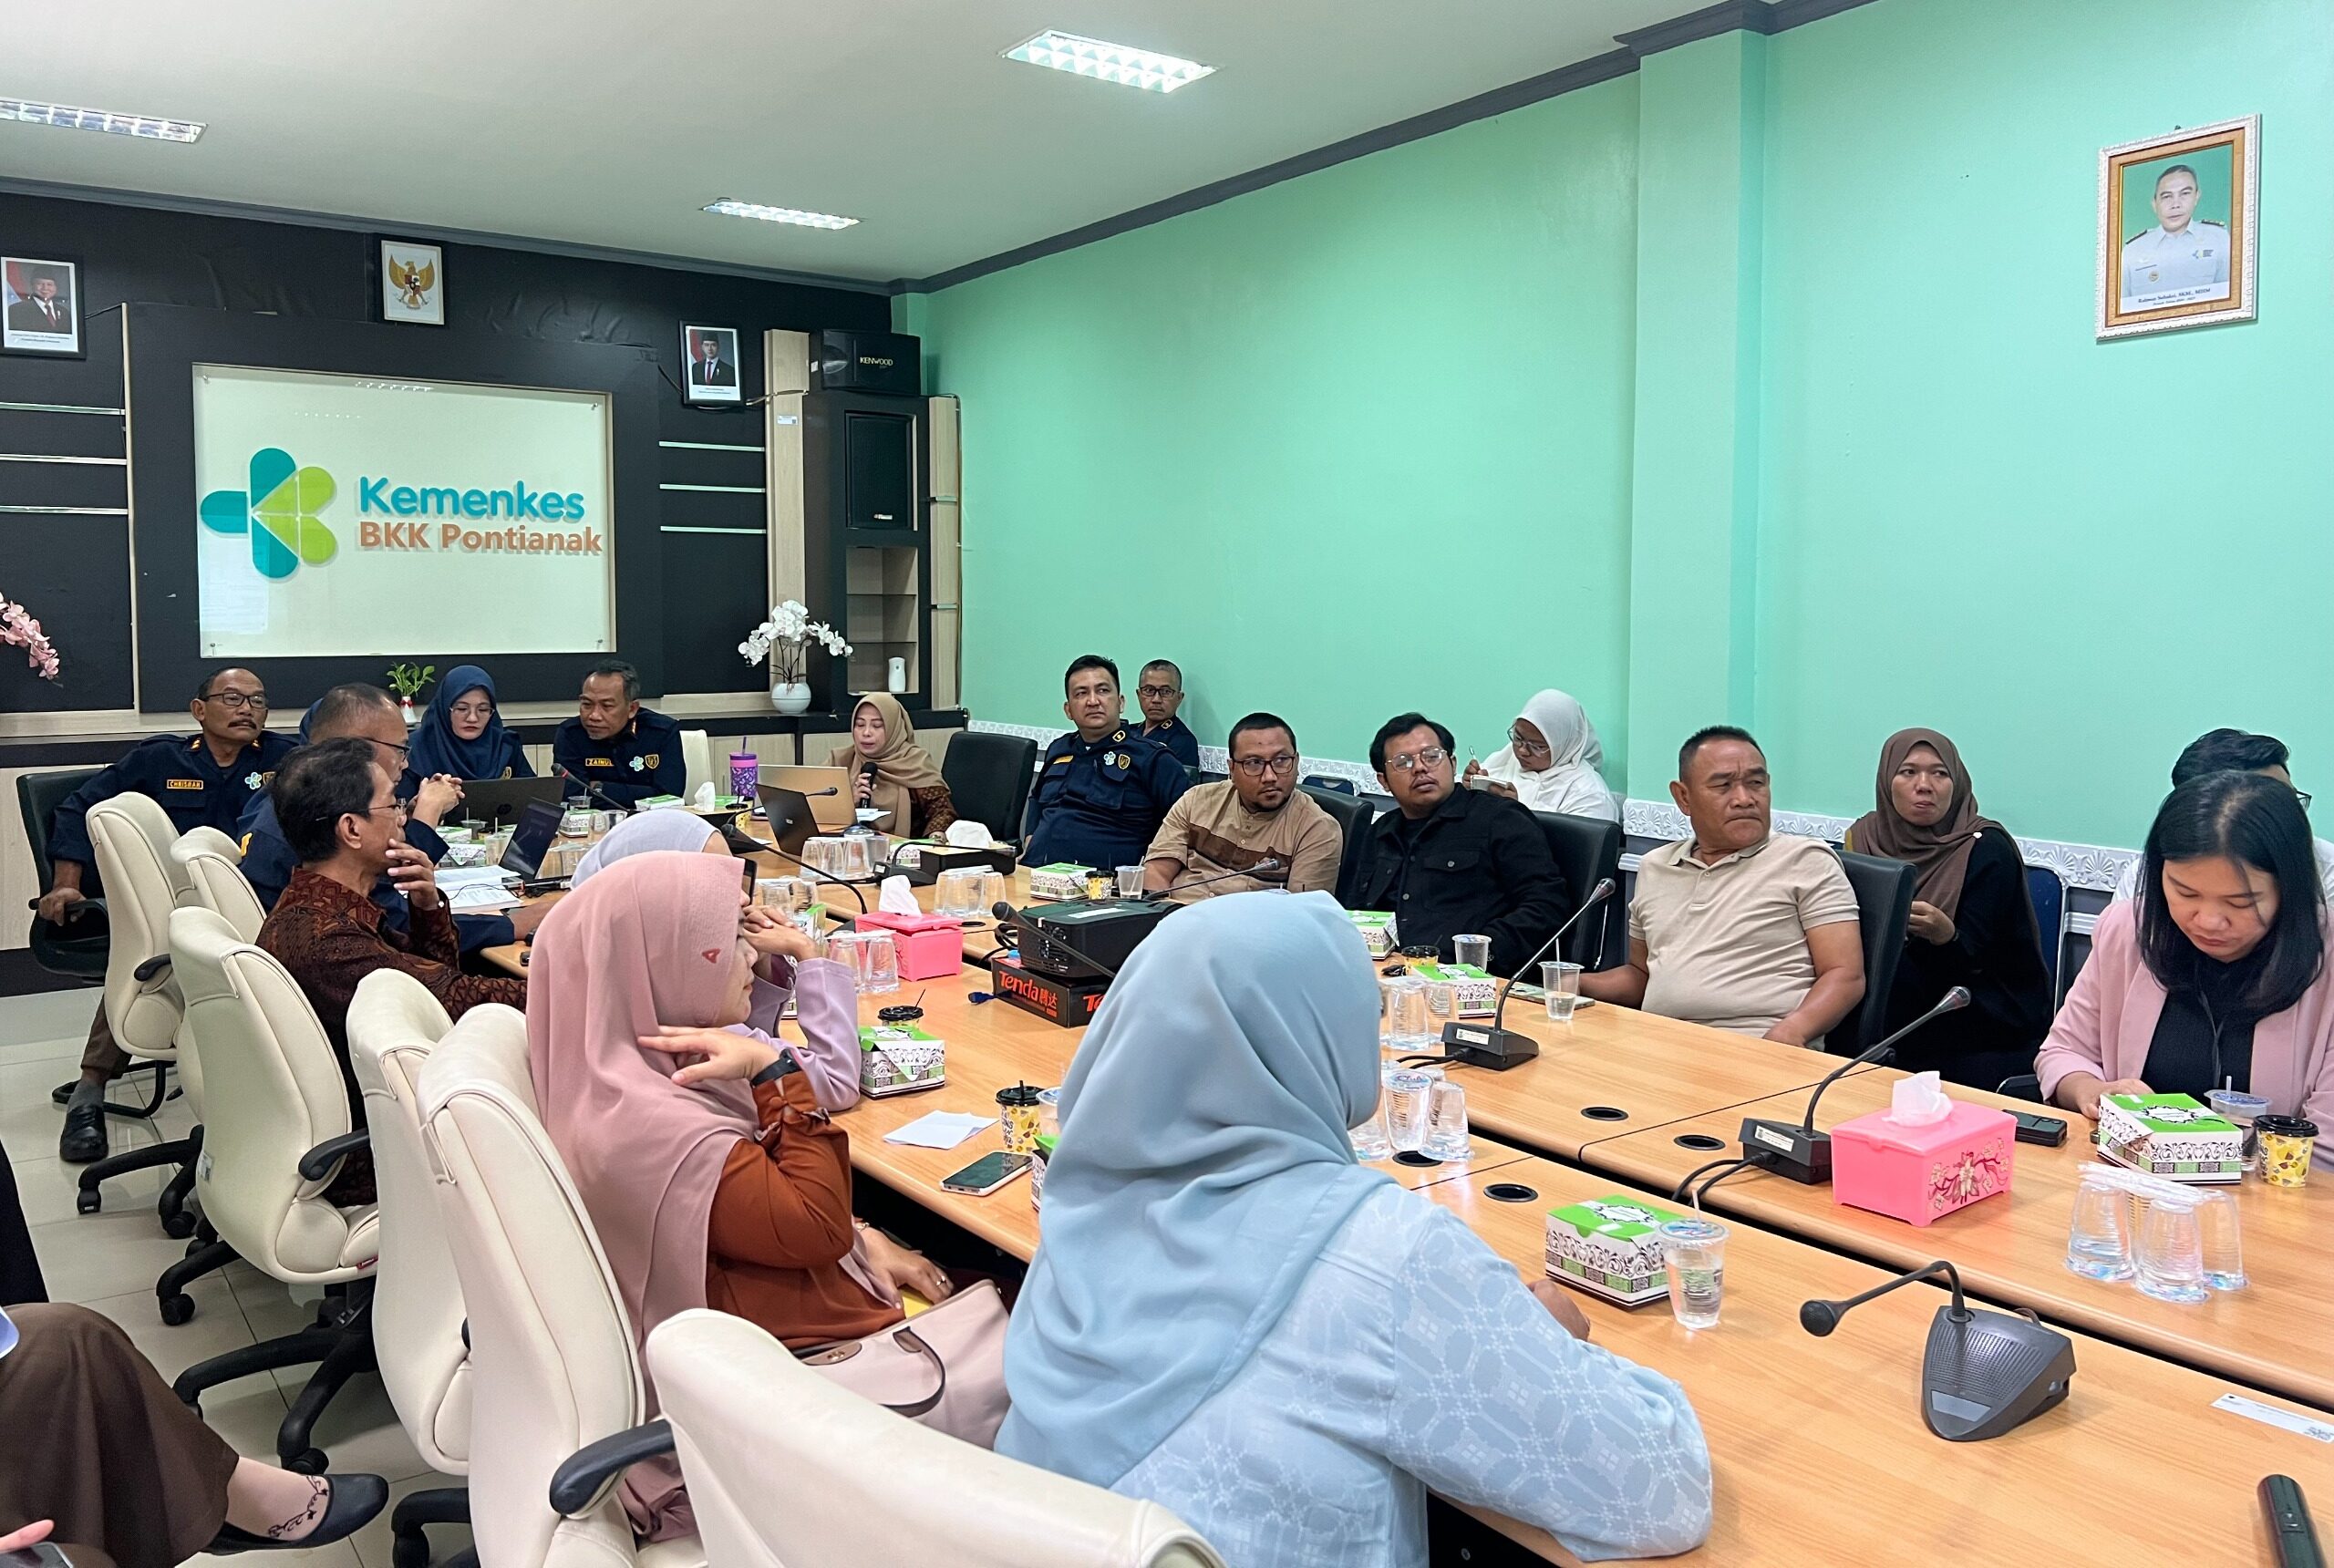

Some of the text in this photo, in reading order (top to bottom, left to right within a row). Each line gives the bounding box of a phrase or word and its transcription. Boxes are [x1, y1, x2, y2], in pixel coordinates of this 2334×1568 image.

[860, 356, 893, 366] KENWOOD
[359, 476, 585, 520] Kemenkes
[359, 521, 602, 552] BKK Pontianak
[998, 970, 1038, 1002] Tenda
